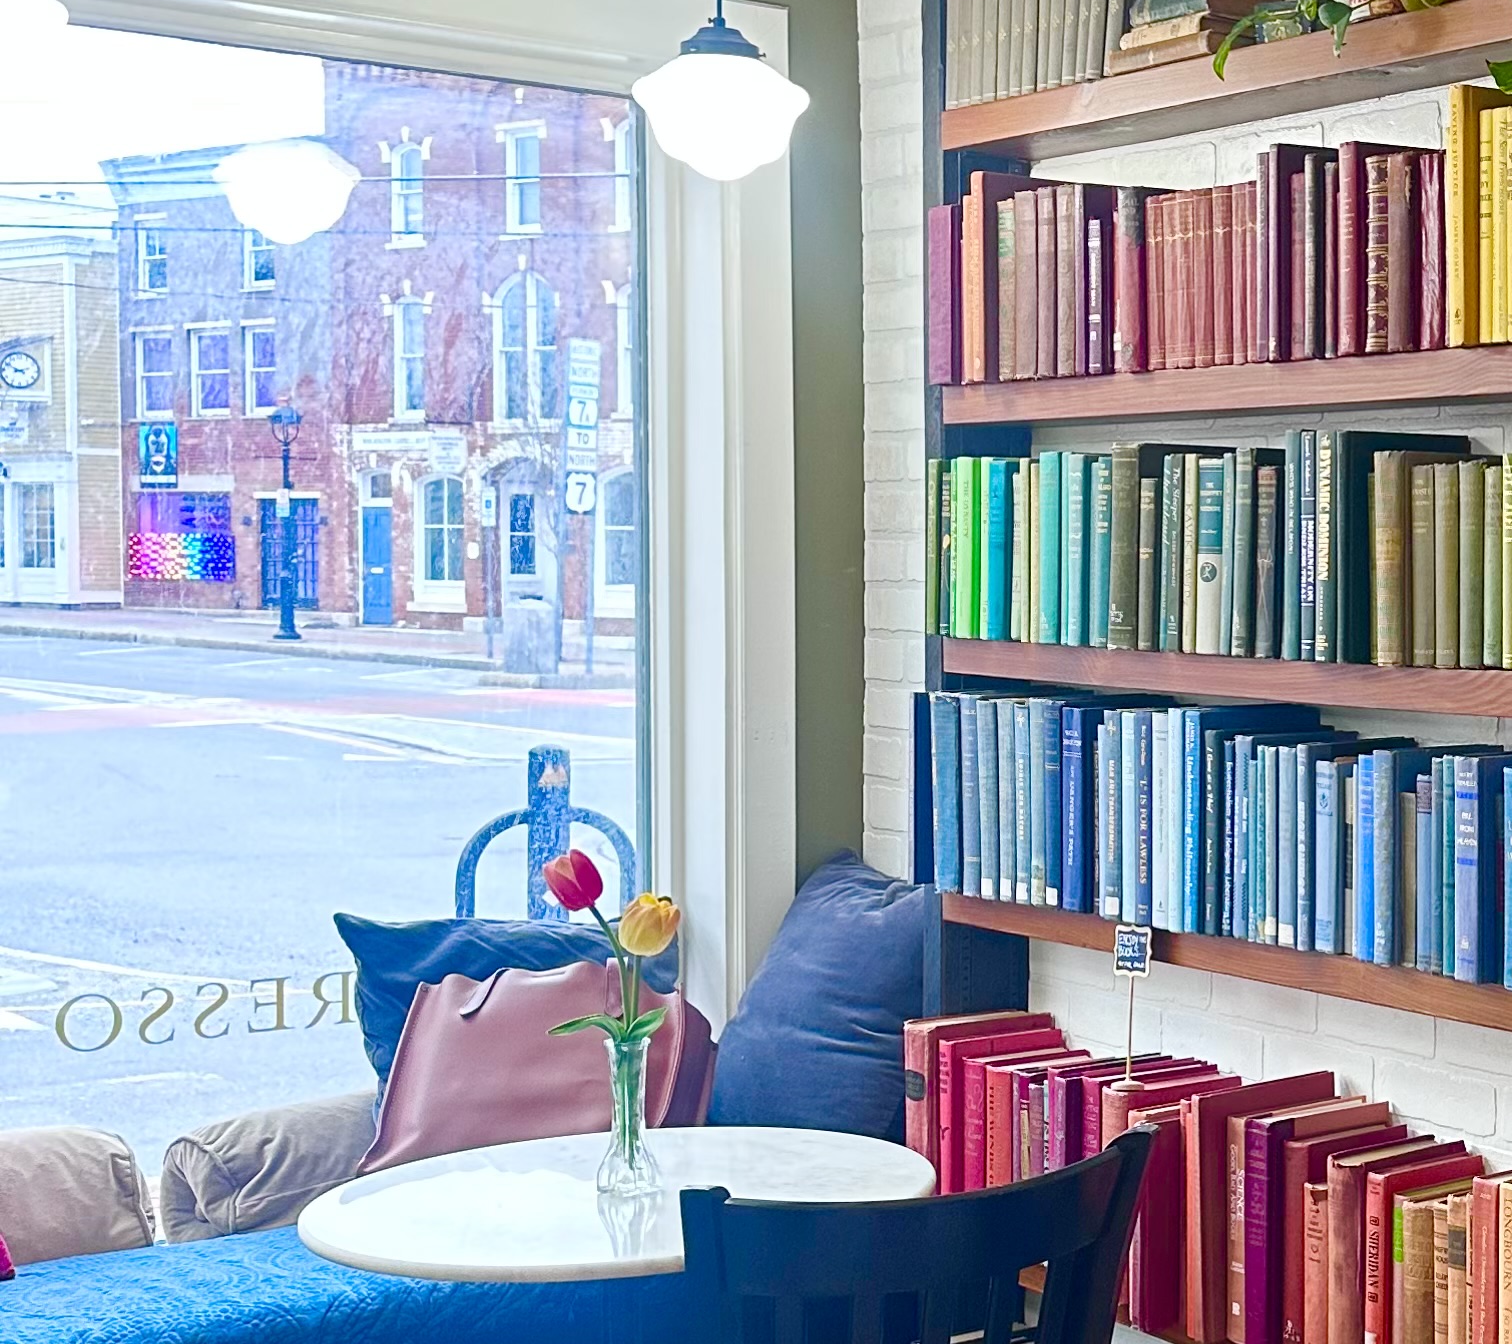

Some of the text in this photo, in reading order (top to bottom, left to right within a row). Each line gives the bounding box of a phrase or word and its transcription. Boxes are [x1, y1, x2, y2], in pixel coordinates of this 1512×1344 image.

[577, 433, 589, 444] TO
[569, 453, 595, 466] NORTH
[575, 482, 587, 498] 7
[1318, 449, 1331, 581] DYNAMIC DOMINION
[1139, 833, 1147, 885] LAWLESS
[1368, 1229, 1380, 1289] SHERIDAN
